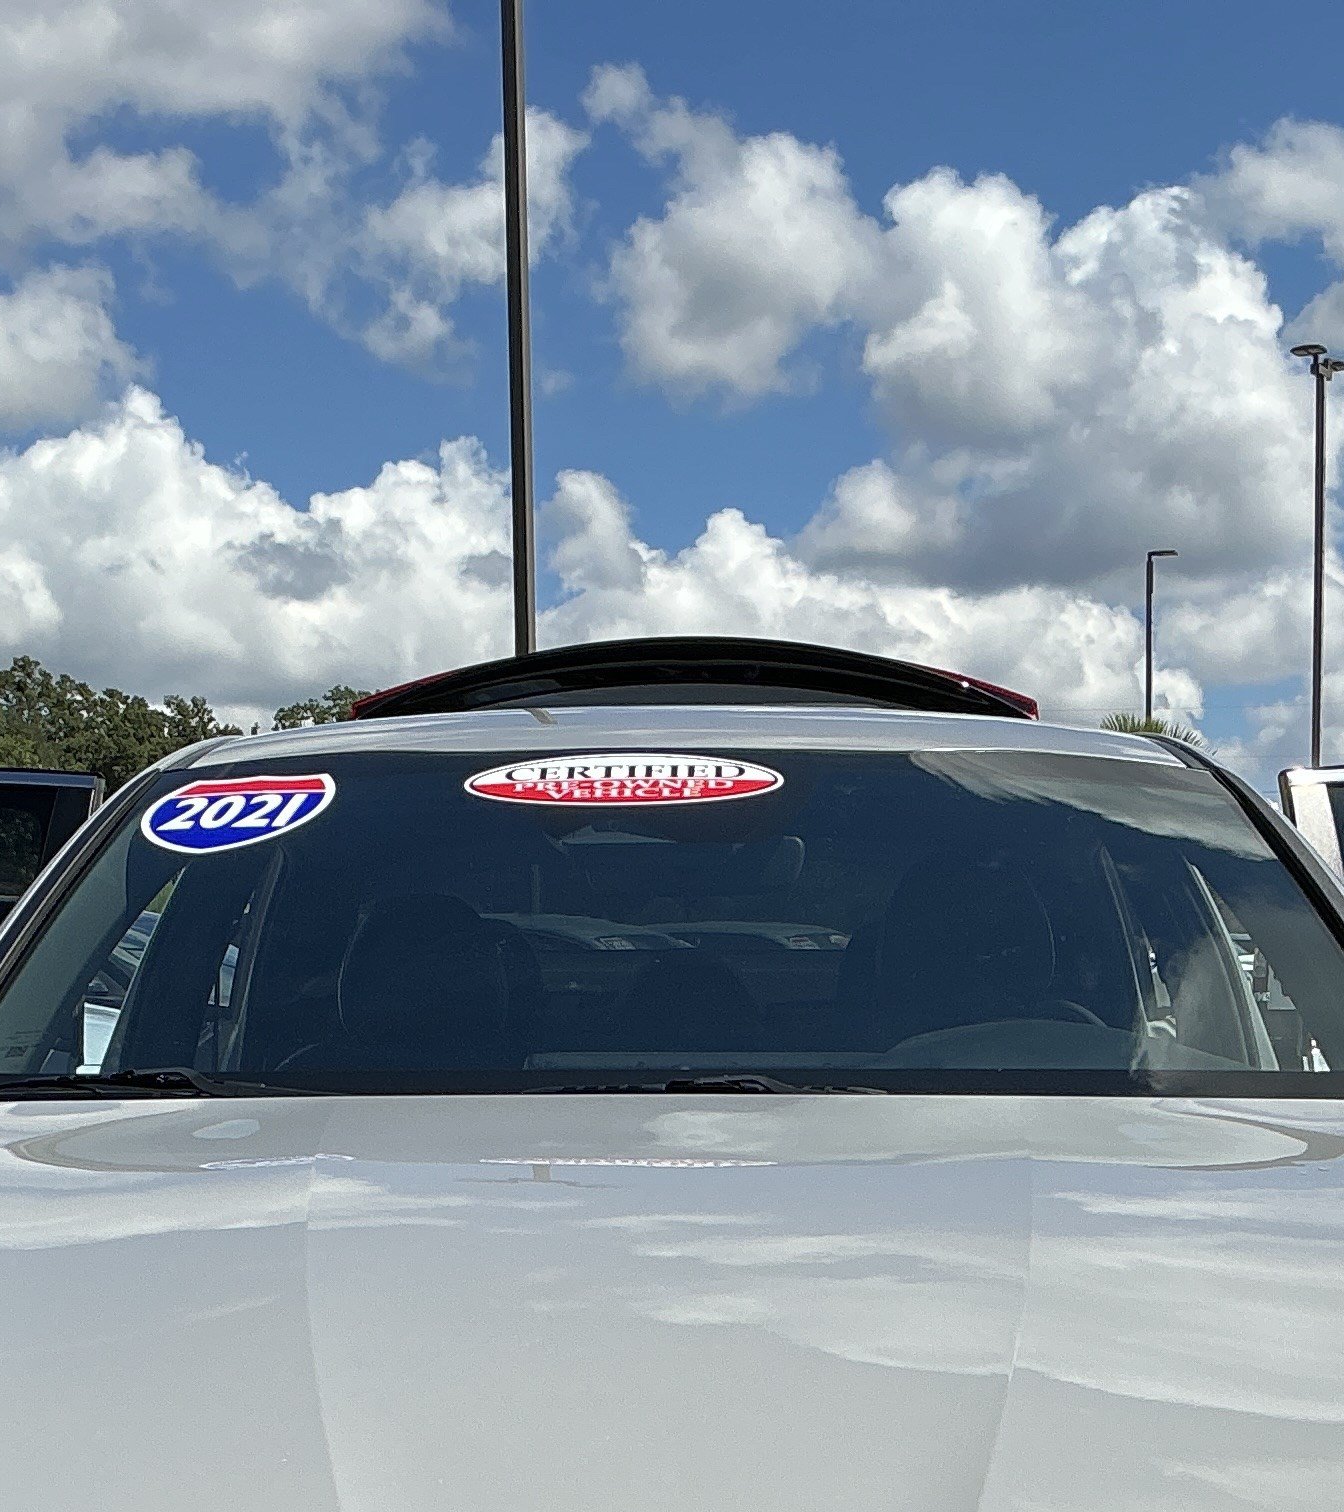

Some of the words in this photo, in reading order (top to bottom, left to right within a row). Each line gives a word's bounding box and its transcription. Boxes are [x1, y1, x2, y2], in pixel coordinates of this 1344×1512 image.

[505, 764, 746, 781] CERTIFIED
[513, 778, 735, 793] PRE-OWNED
[545, 786, 703, 799] VEHICLE
[157, 794, 301, 831] 2021
